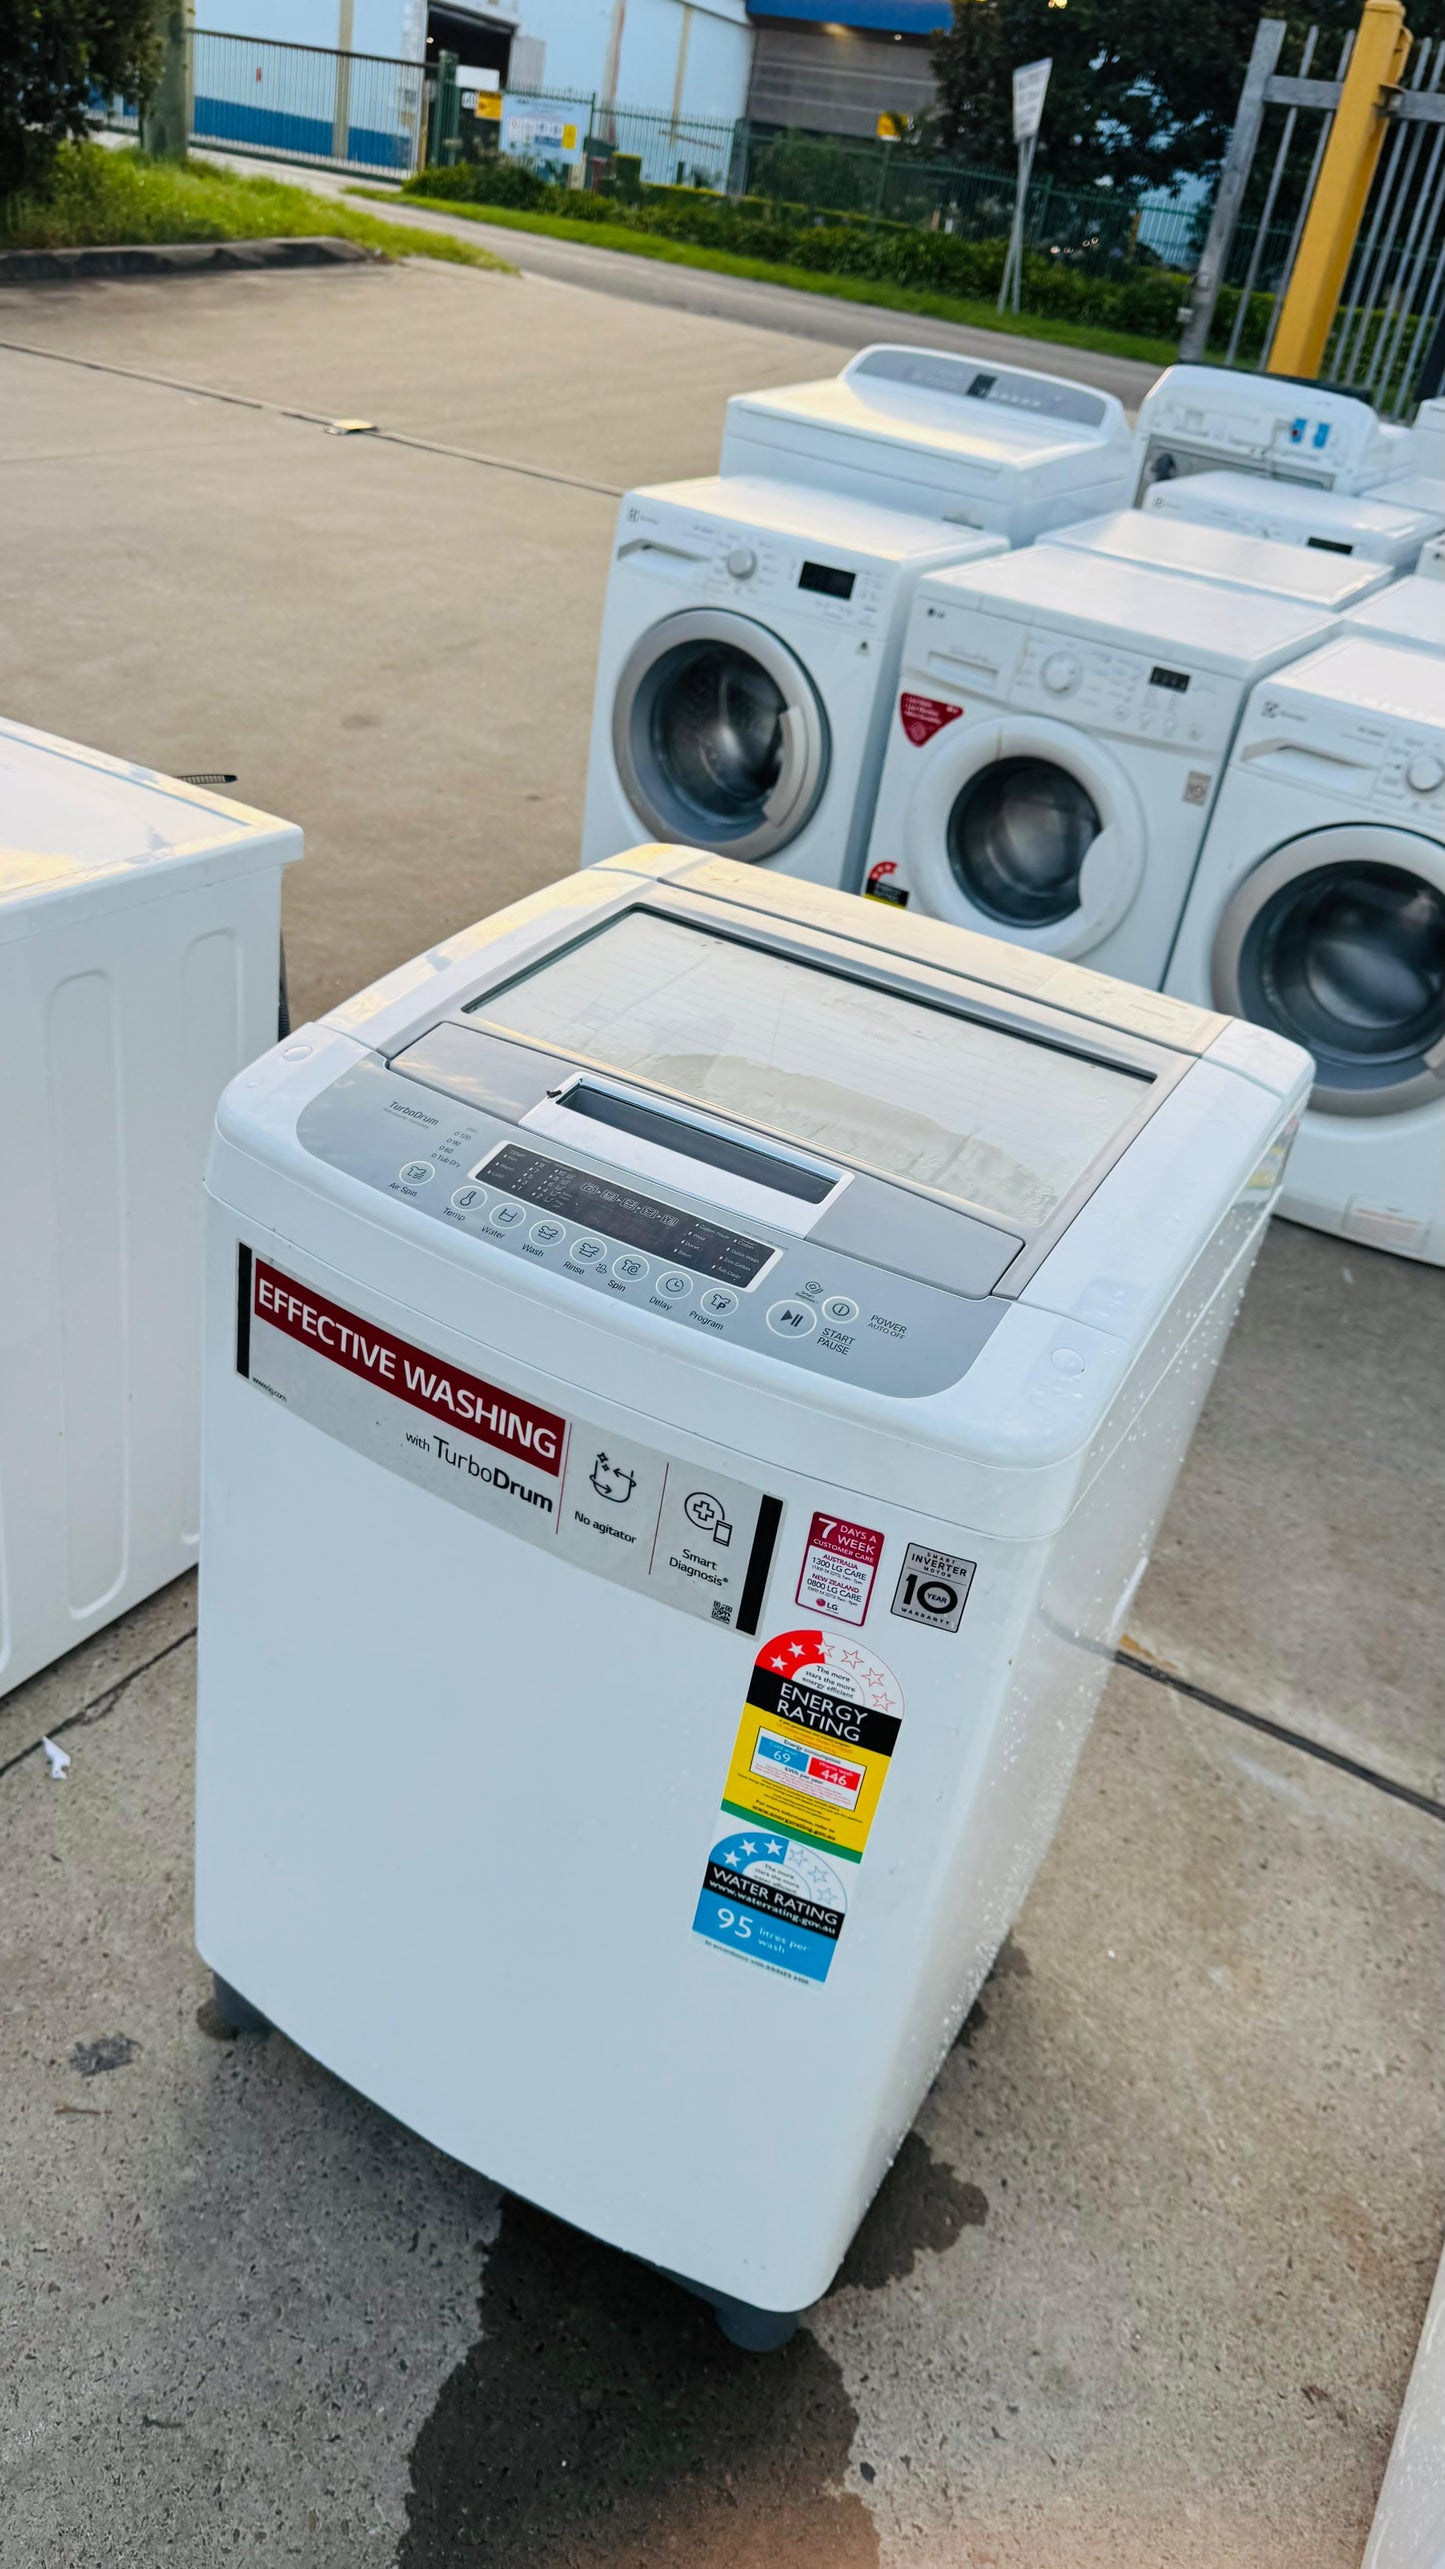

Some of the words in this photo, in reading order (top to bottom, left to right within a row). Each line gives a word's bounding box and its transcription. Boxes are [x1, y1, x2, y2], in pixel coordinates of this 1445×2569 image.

[389, 1100, 439, 1126] TurboDrum
[389, 1182, 400, 1190] Air
[401, 1186, 418, 1198] Spin
[443, 1207, 465, 1222] Temp
[481, 1225, 506, 1240] Water
[521, 1243, 544, 1258] Wash
[562, 1260, 585, 1276] Rinse
[607, 1279, 626, 1292] Spin
[649, 1296, 673, 1312] Delay
[689, 1310, 724, 1331] Program
[870, 1314, 907, 1334] POWER
[822, 1327, 855, 1345] START
[868, 1322, 890, 1334] AUTO
[890, 1330, 906, 1340] OFF
[816, 1337, 850, 1355] PAUSE
[258, 1278, 396, 1380] EFFECTIVE
[404, 1359, 557, 1459] WASHING
[406, 1432, 430, 1452] with
[433, 1435, 554, 1513] TurboDrum
[574, 1510, 590, 1526] No
[592, 1520, 637, 1544] agitator
[818, 1517, 837, 1539] 7
[840, 1525, 867, 1540] DAYS
[869, 1535, 877, 1544] A
[813, 1538, 853, 1556] CUSTOMER
[855, 1553, 874, 1563] CARE
[838, 1534, 876, 1555] WEEK
[682, 1548, 718, 1571] Smart
[823, 1554, 858, 1570] AUSTRALIA
[912, 1553, 967, 1576] INVERTER
[927, 1552, 956, 1564] SMART
[812, 1557, 830, 1568] 1300
[832, 1564, 843, 1572] LG
[844, 1568, 867, 1581] CARE
[924, 1566, 952, 1578] MOTOR
[807, 1578, 826, 1590] 0800
[827, 1585, 838, 1594] LG
[840, 1590, 862, 1602] CARE
[812, 1573, 828, 1582] NEW
[829, 1579, 859, 1593] ZEALAND
[903, 1574, 958, 1614] 10
[927, 1593, 947, 1604] YEAR
[827, 1602, 838, 1610] LG
[902, 1607, 950, 1625] WARRANTY
[806, 1671, 821, 1680] stars
[824, 1677, 835, 1685] the
[837, 1683, 855, 1692] more
[817, 1665, 829, 1675] The
[831, 1672, 850, 1682] more
[802, 1677, 825, 1690] energy
[827, 1686, 853, 1698] efficient
[780, 1682, 868, 1724] ENERGY
[777, 1699, 861, 1742] RATING
[784, 1739, 803, 1751] Energy
[773, 1750, 791, 1763] 69
[821, 1769, 847, 1786] 446
[765, 1864, 776, 1872] The
[714, 1867, 768, 1900] WATER
[774, 1894, 838, 1925] RATING
[710, 1880, 836, 1935] www.waterrating.gov.au
[717, 1908, 754, 1939] 95
[760, 1928, 786, 1944] litres
[790, 1940, 809, 1951] per
[758, 1939, 785, 1954] wash
